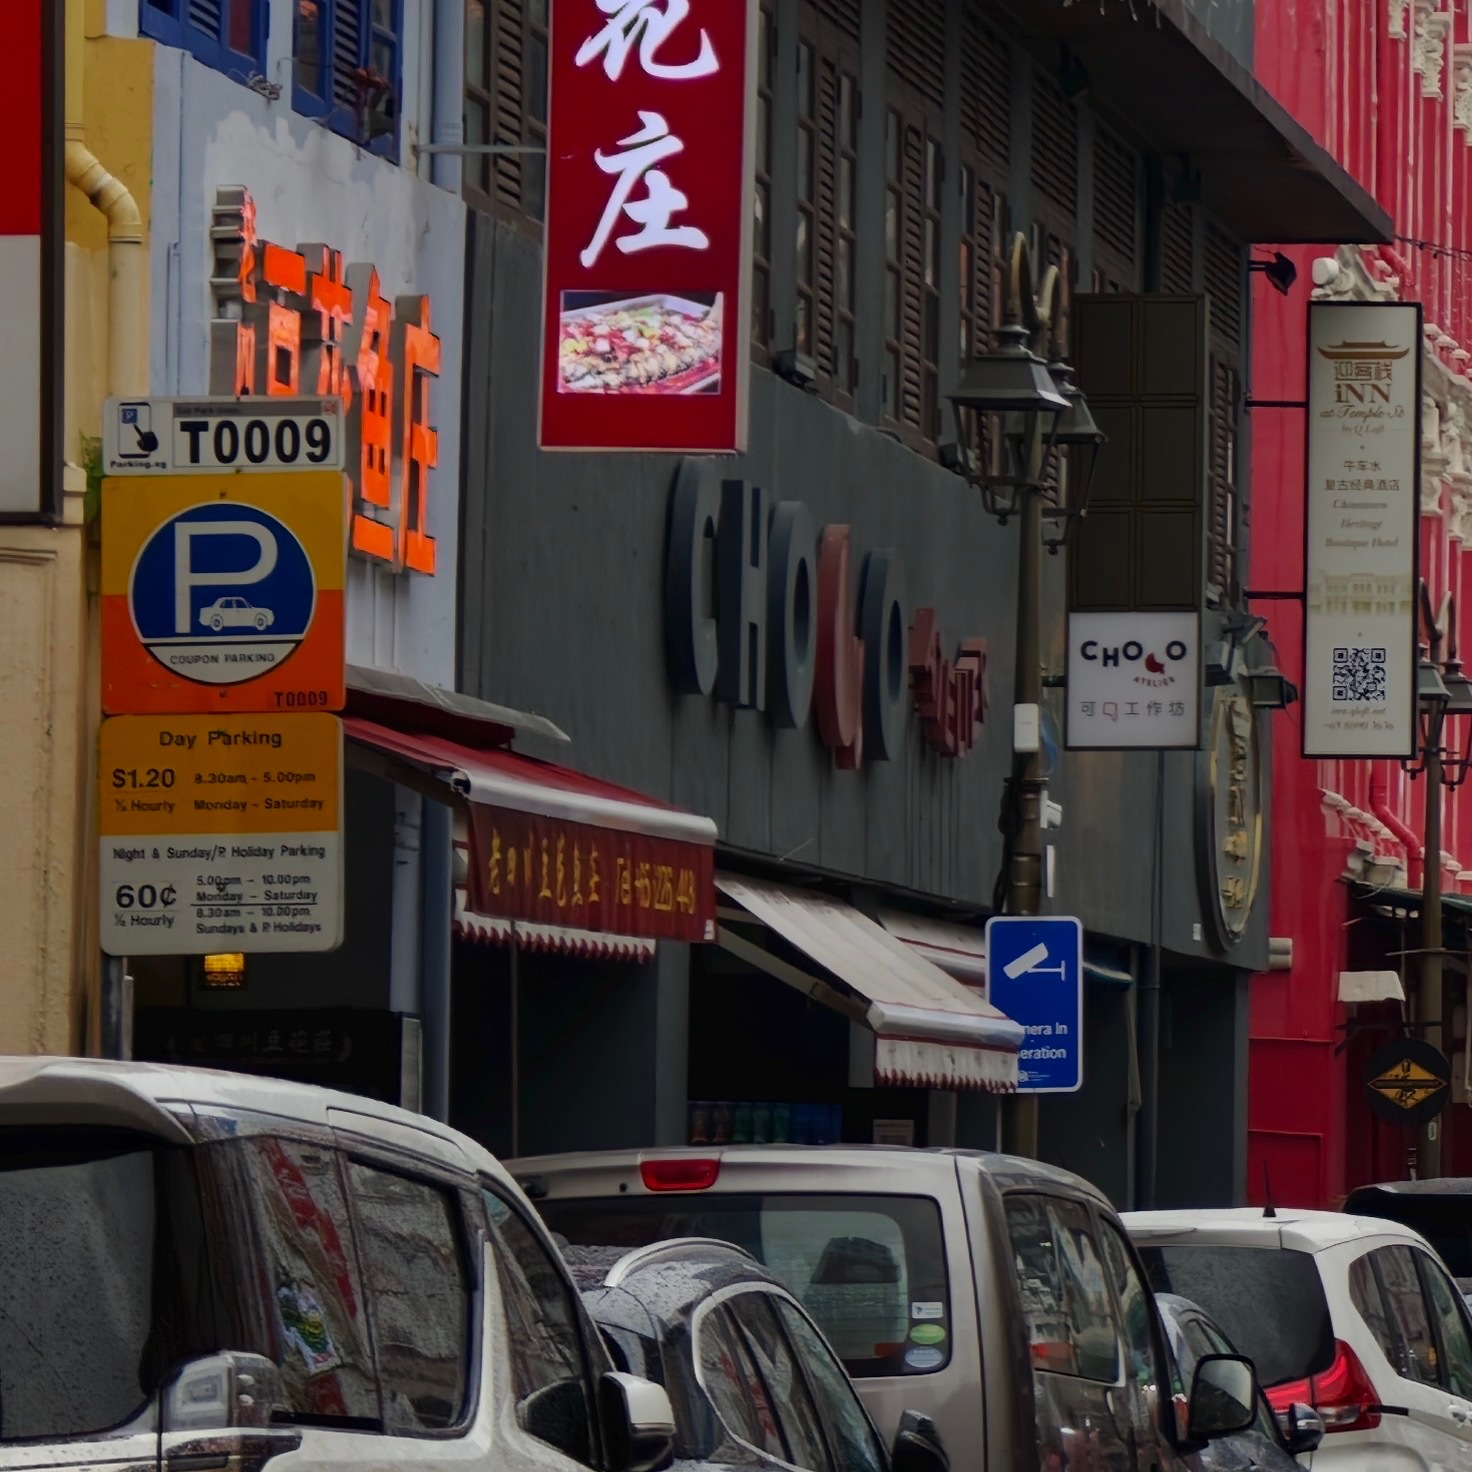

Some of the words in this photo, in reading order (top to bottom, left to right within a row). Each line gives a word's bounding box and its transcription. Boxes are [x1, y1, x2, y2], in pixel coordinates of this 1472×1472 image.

[180, 419, 331, 463] T0009
[170, 653, 219, 665] COUPON
[224, 652, 275, 664] PARKING
[159, 731, 197, 749] Day
[208, 729, 283, 748] Parking
[111, 767, 176, 790] $1.20
[193, 772, 247, 785] 8.30am
[262, 771, 317, 785] 5.00pm
[131, 799, 176, 814] Hourly
[193, 799, 248, 813] Monday
[264, 797, 325, 811] Saturday
[112, 847, 146, 862] Night
[231, 845, 275, 860] Holiday
[280, 844, 326, 860] Parking
[196, 889, 243, 903] Monday
[263, 888, 318, 904] Saturday
[130, 914, 176, 929] Hourly
[196, 922, 244, 935] Sundays
[273, 921, 322, 934] Holidays
